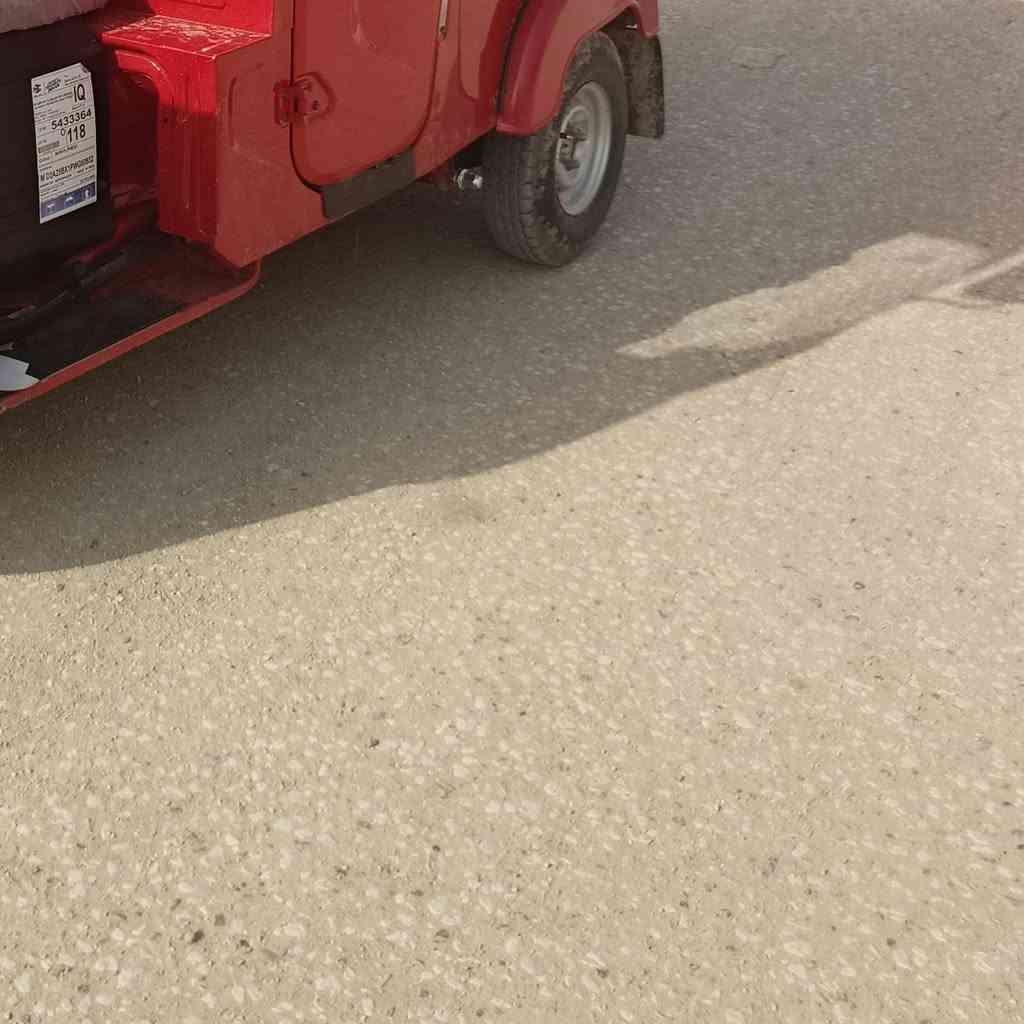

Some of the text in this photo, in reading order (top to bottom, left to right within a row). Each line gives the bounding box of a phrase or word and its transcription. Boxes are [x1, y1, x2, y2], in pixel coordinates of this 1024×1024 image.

[73, 84, 86, 103] IQ
[51, 108, 92, 130] 5433364
[67, 123, 86, 145] 118
